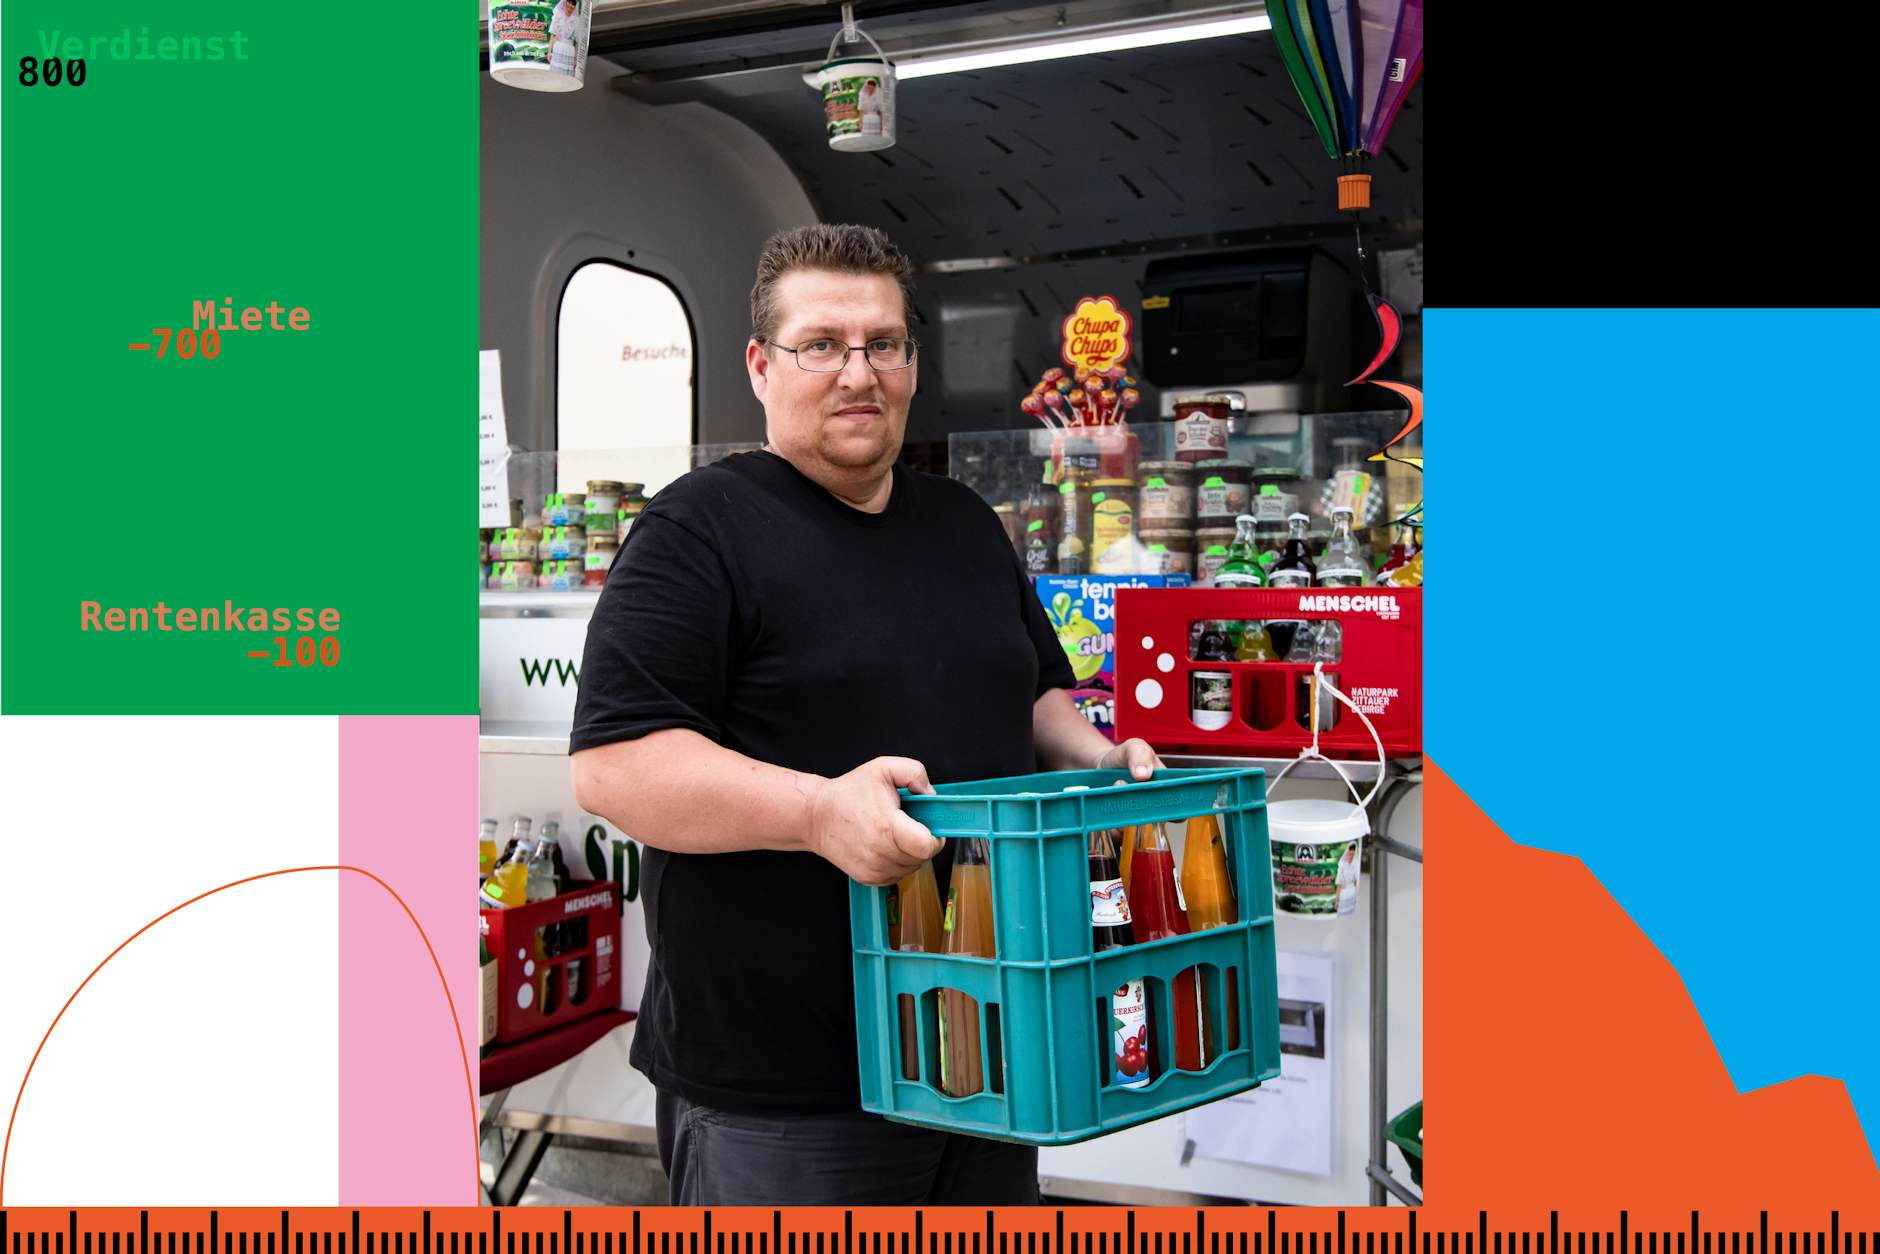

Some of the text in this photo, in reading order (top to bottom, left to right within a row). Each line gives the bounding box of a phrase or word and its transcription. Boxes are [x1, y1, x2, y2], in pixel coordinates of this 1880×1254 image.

[497, 9, 519, 21] Echte
[1073, 317, 1120, 338] Chupa
[1070, 336, 1118, 364] Chups
[1026, 549, 1049, 563] Grill
[1299, 595, 1400, 612] MENSCHEL
[1351, 687, 1398, 697] NATURPARK
[1351, 696, 1390, 706] ZITTAUER
[1100, 798, 1151, 815] NATURELLA
[1281, 864, 1306, 877] Echte
[564, 890, 613, 914] MENSCHEL
